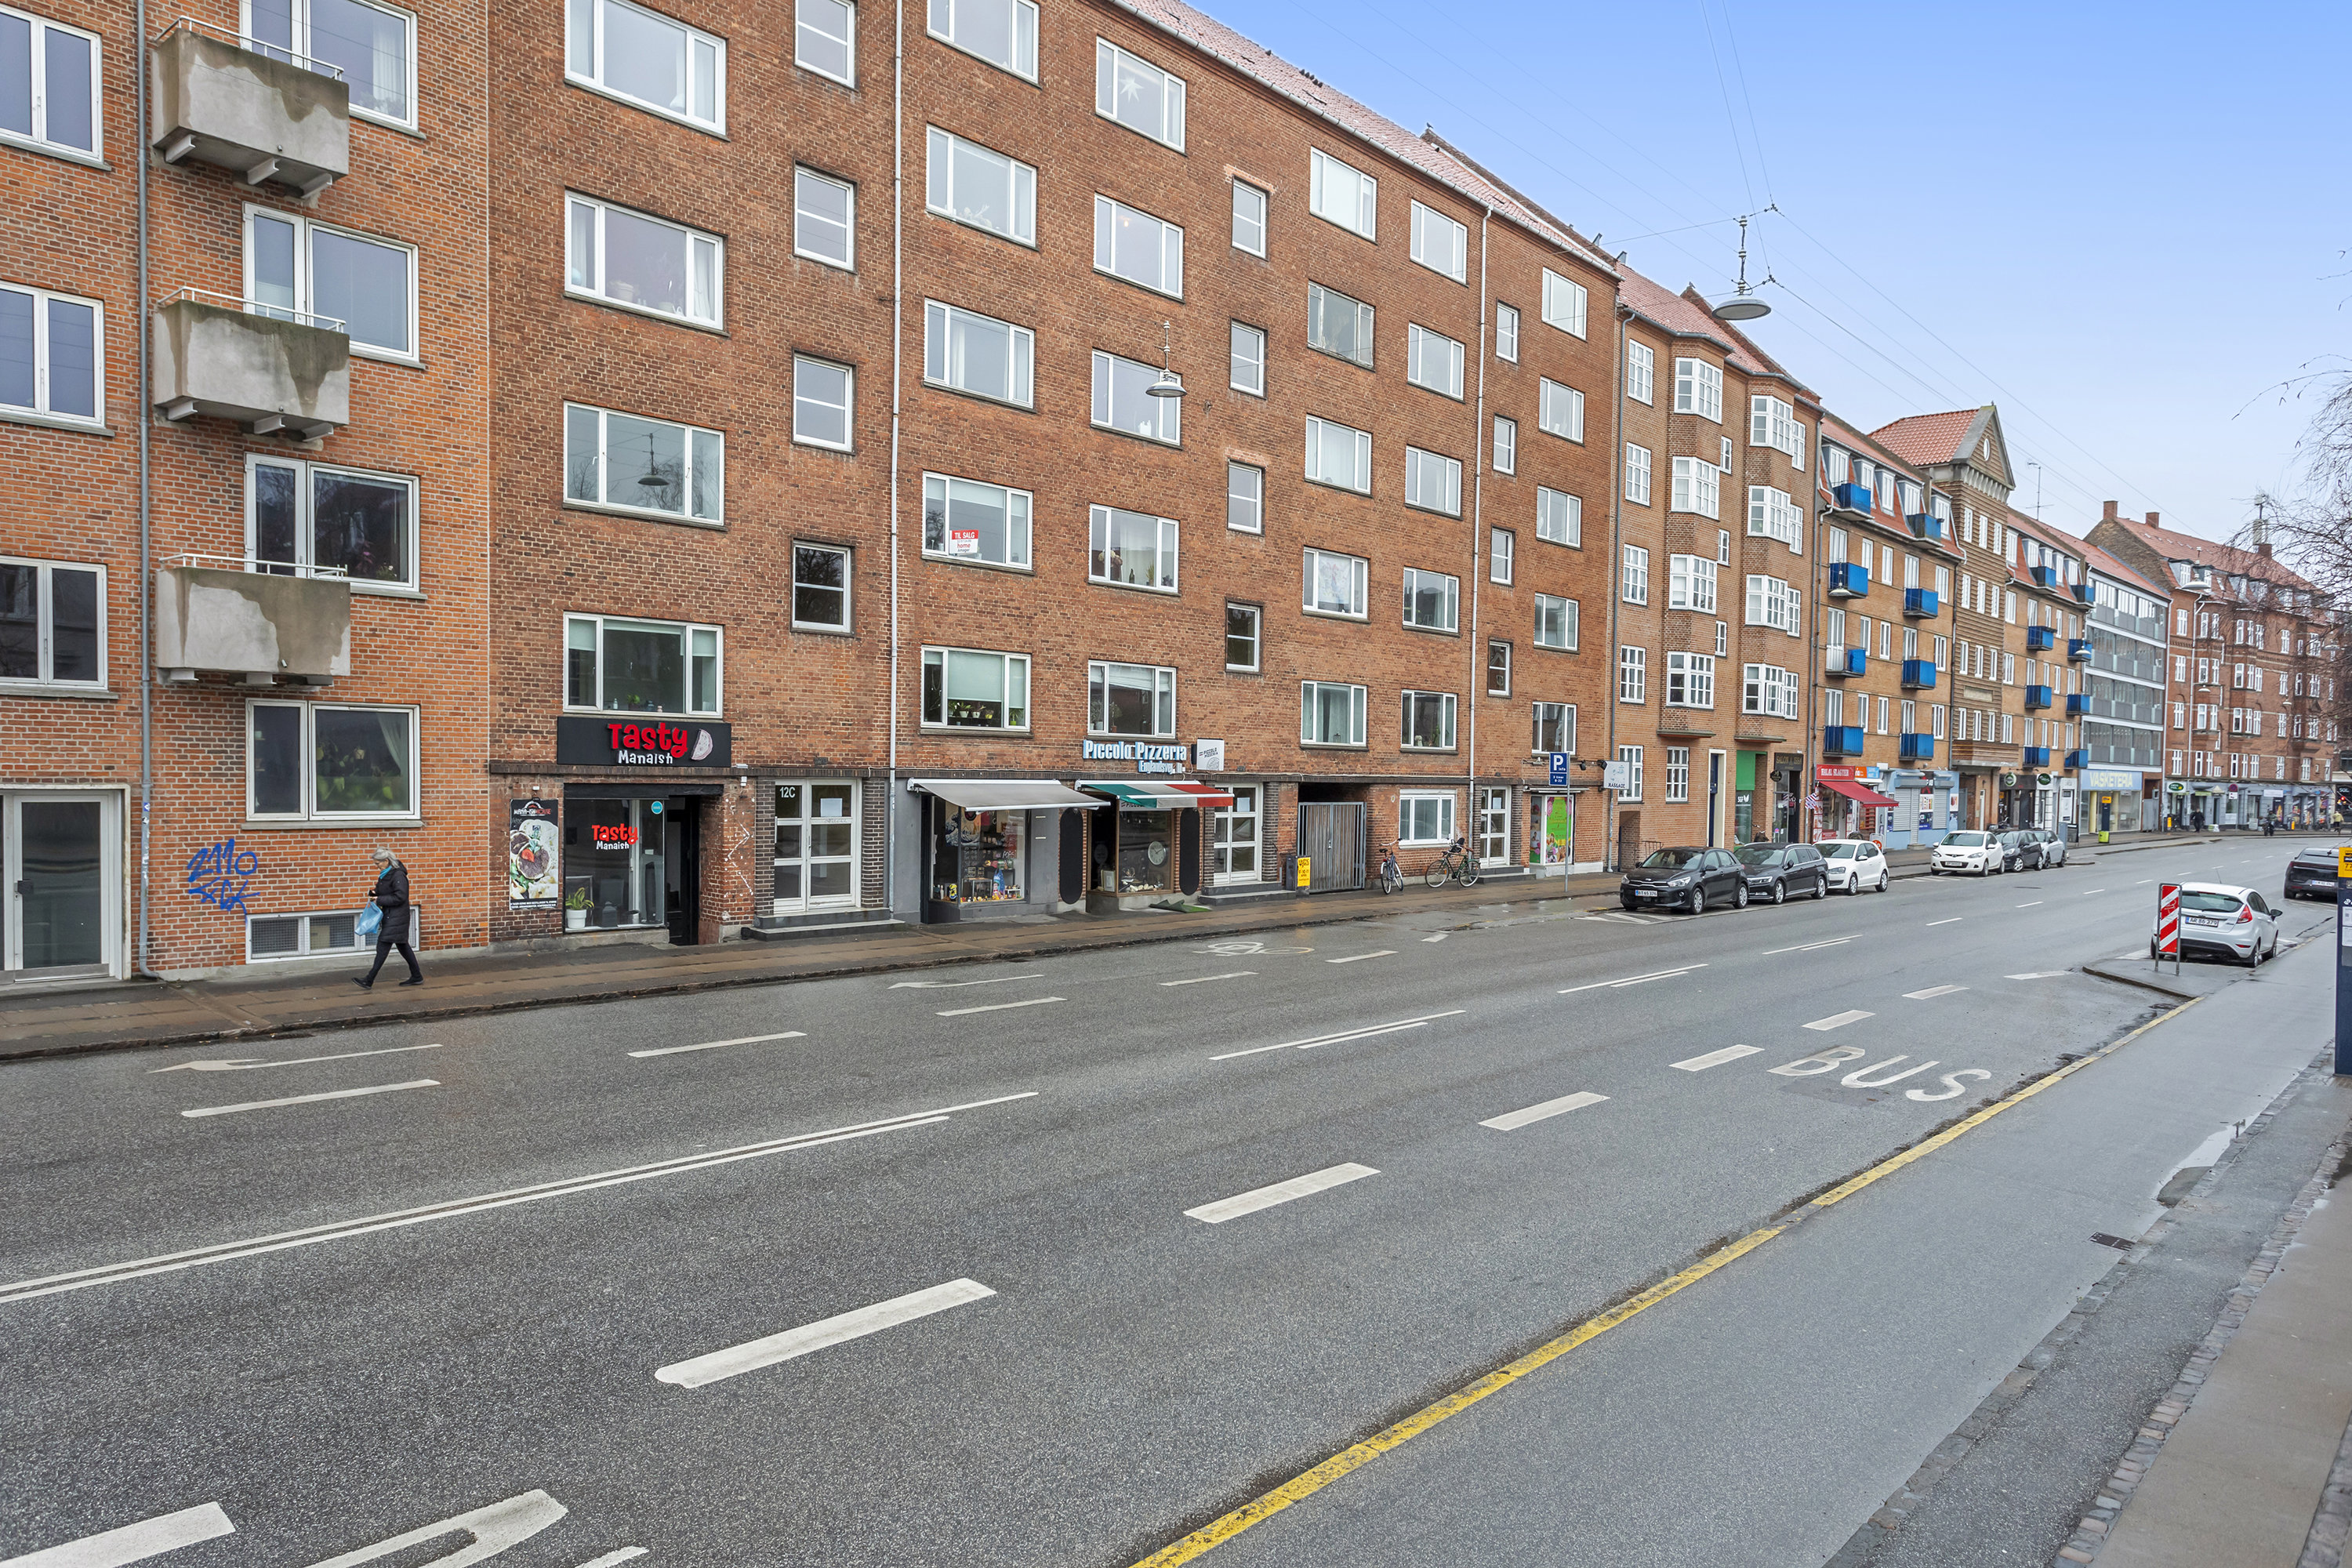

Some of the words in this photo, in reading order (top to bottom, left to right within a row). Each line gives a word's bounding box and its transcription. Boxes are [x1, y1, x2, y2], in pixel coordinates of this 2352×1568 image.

[608, 722, 688, 758] Tasty
[618, 750, 673, 764] Manaish
[1083, 739, 1131, 760] Piccolo
[1135, 741, 1187, 760] Pizzeria
[1553, 754, 1564, 771] P
[2089, 771, 2132, 787] VASKETERIA
[779, 786, 796, 798] 12C
[592, 823, 639, 845] Tasty
[596, 840, 630, 851] Manaish
[1766, 1046, 1991, 1101] BUS
